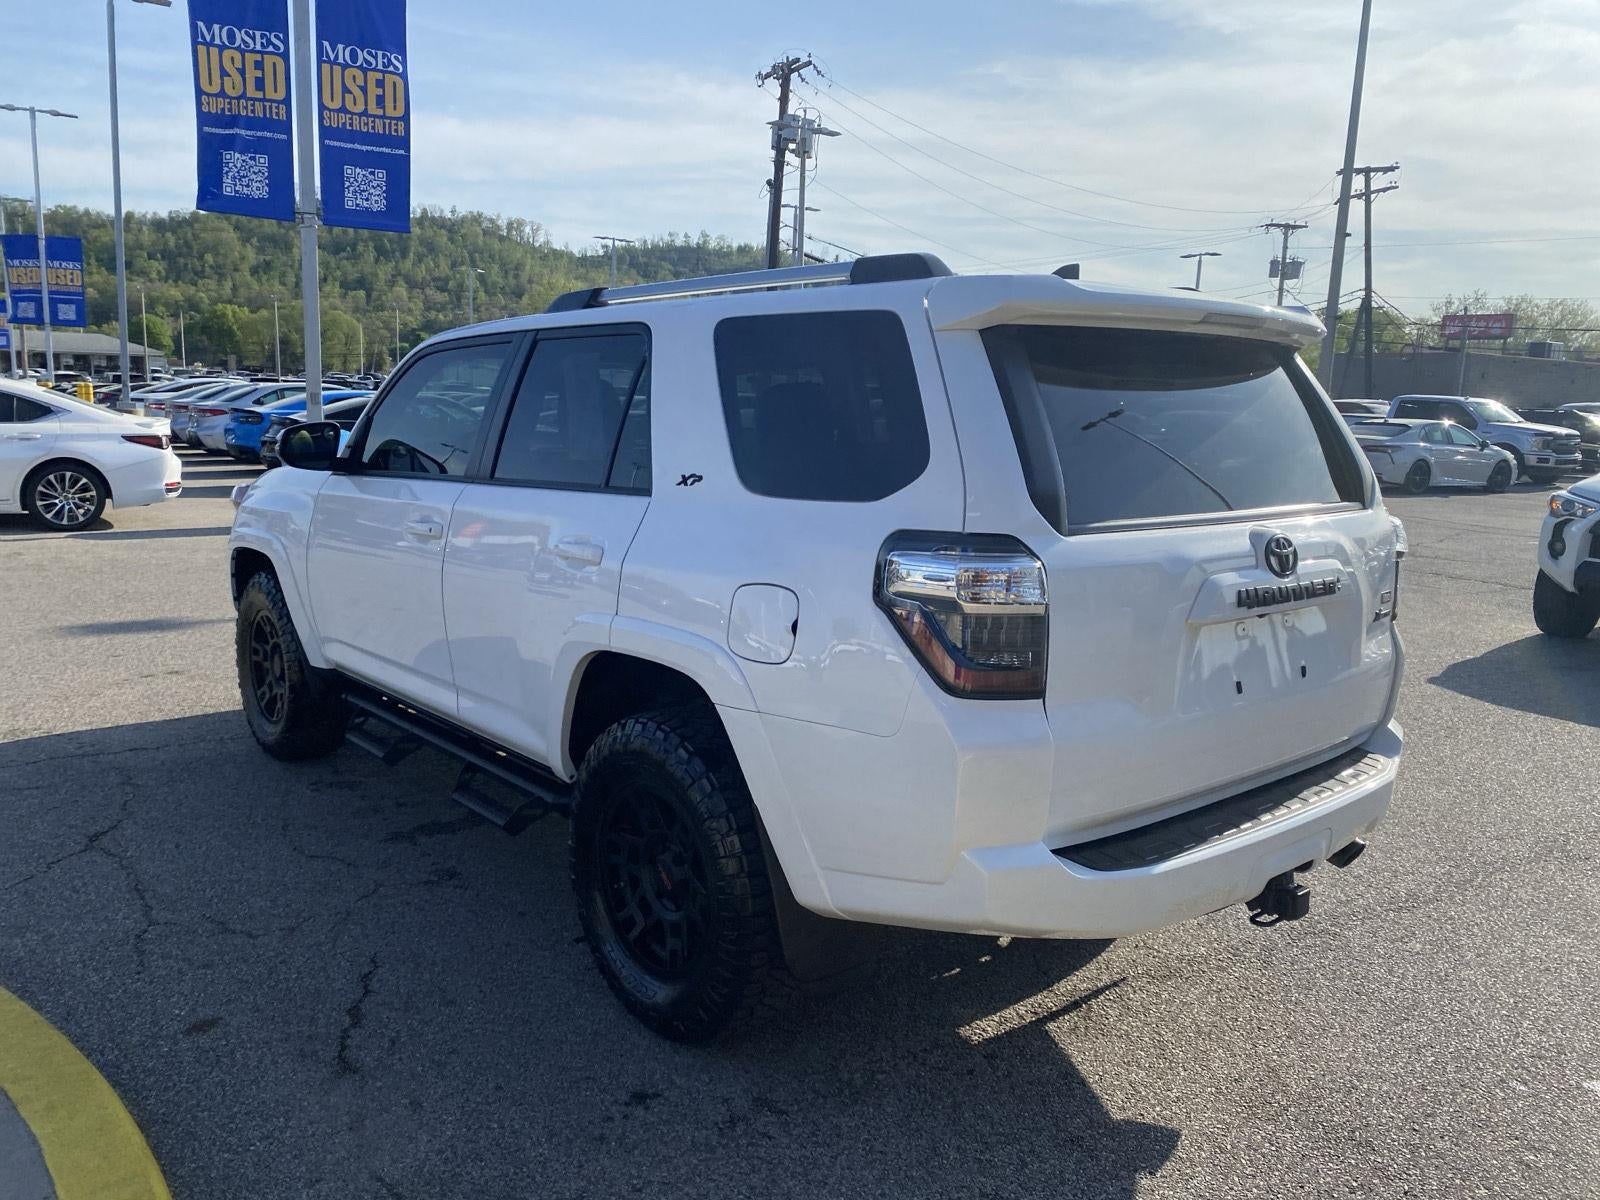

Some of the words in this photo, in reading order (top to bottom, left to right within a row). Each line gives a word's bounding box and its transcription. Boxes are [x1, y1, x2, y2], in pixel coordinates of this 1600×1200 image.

[196, 21, 284, 53] MOSES
[322, 41, 403, 73] MOSES
[197, 45, 287, 101] USED
[321, 63, 405, 117] USED
[201, 95, 287, 121] SUPERCENTER
[323, 111, 405, 136] SUPERCENTER
[47, 260, 81, 270] MOSES
[47, 268, 82, 286] USED
